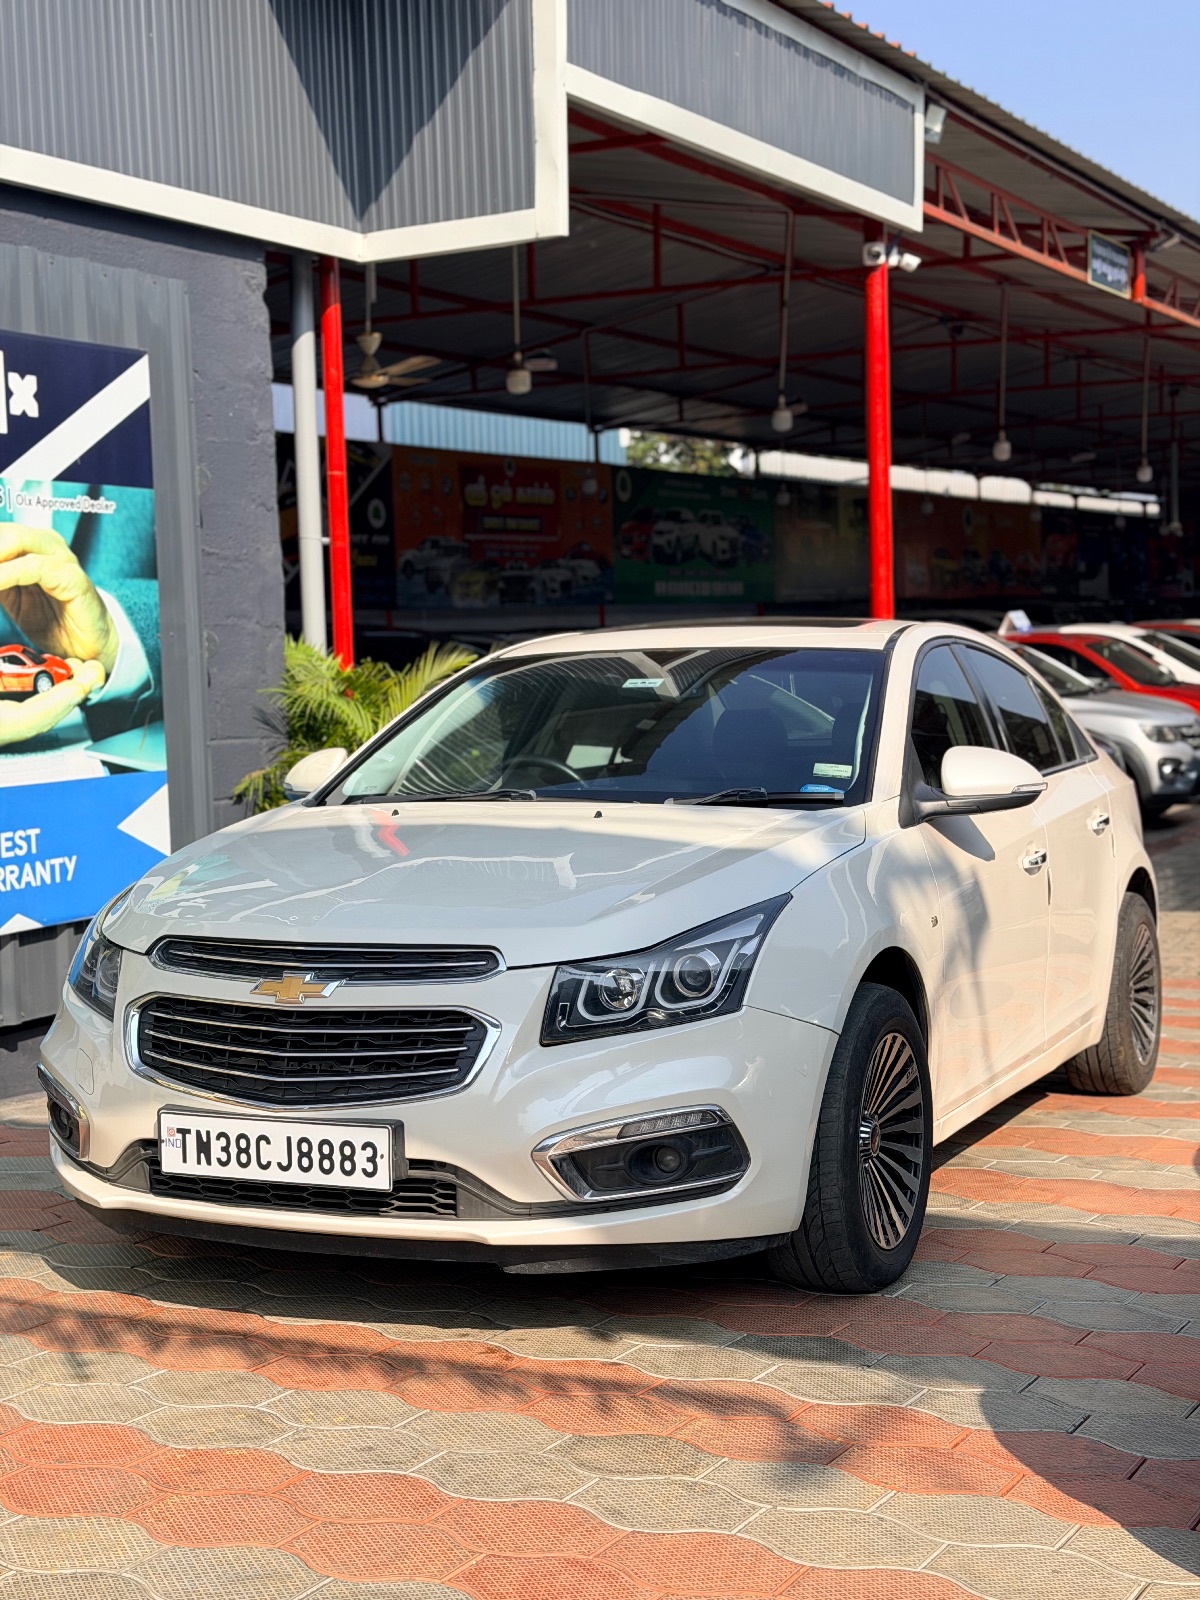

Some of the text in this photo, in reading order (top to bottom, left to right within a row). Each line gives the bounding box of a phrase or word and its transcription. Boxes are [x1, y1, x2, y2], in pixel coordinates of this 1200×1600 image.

[35, 495, 81, 511] Approved
[83, 497, 115, 511] Dealer
[0, 828, 41, 859] EST
[165, 1137, 182, 1149] IND
[176, 1127, 379, 1178] TN38CJ8883
